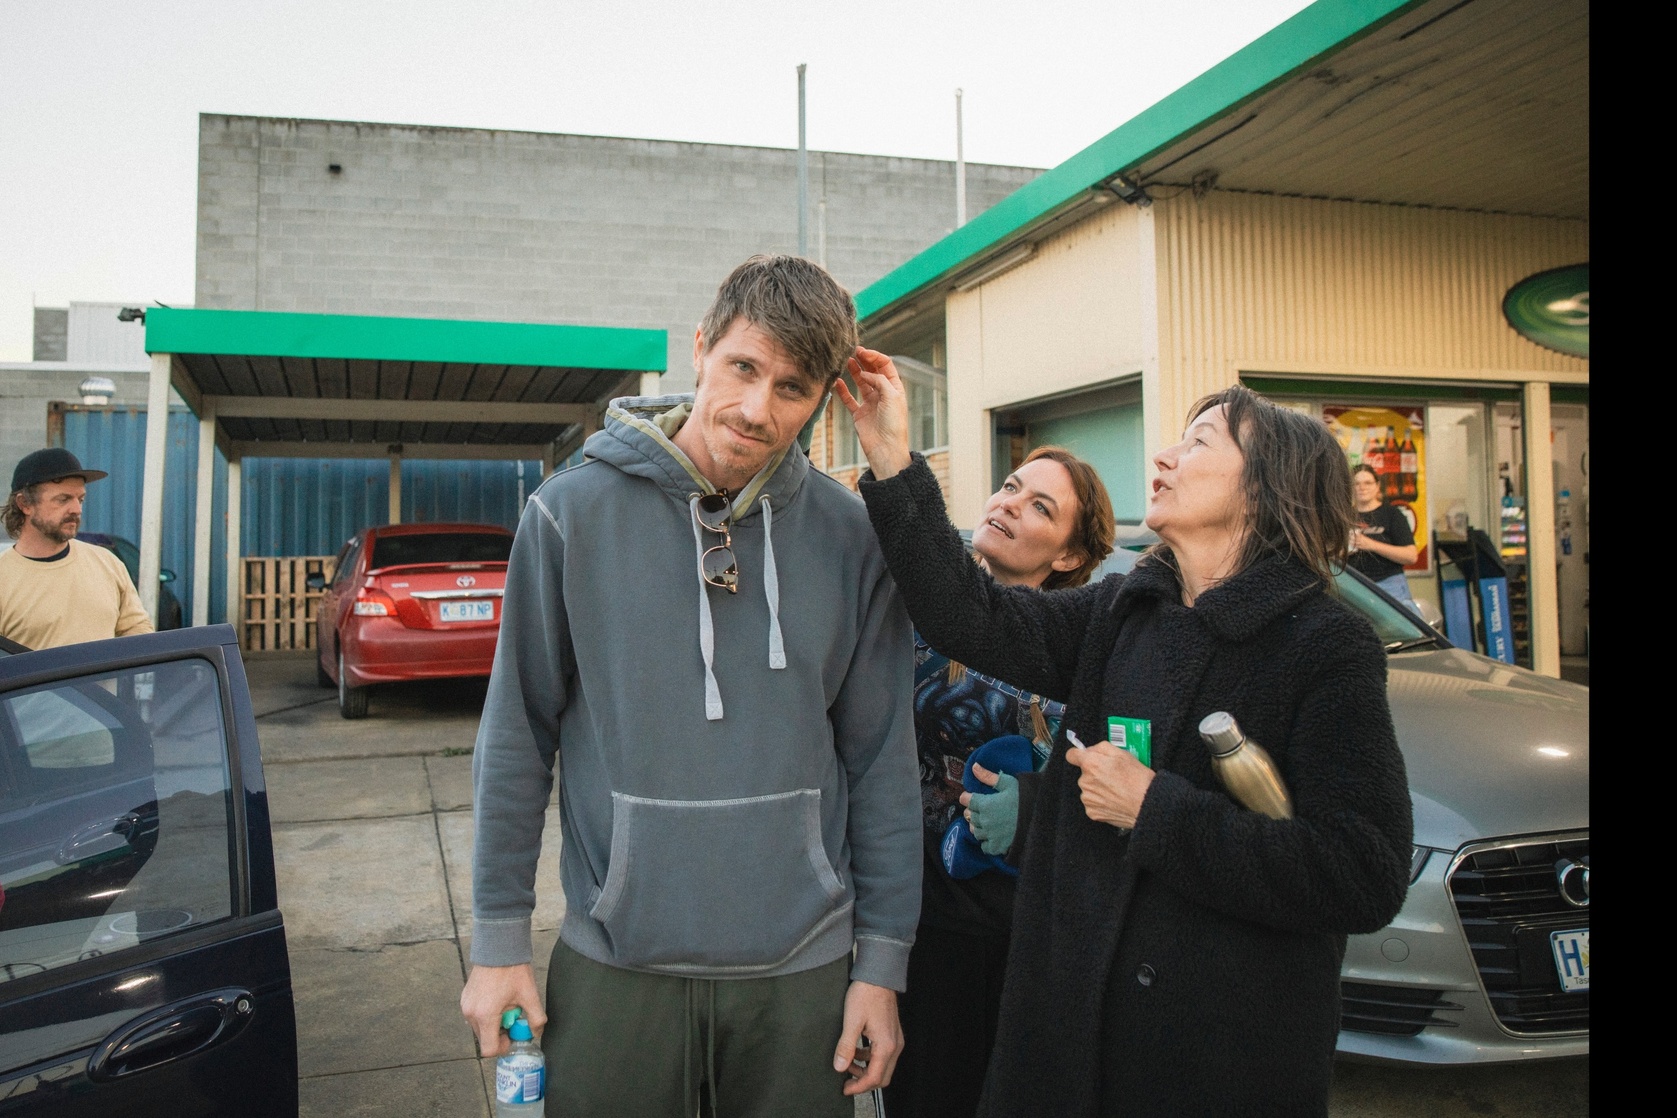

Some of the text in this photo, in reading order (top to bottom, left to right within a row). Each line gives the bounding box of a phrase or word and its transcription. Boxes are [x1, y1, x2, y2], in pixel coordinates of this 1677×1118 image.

[442, 604, 449, 616] K
[1558, 939, 1584, 977] H
[1574, 976, 1589, 985] Tas
